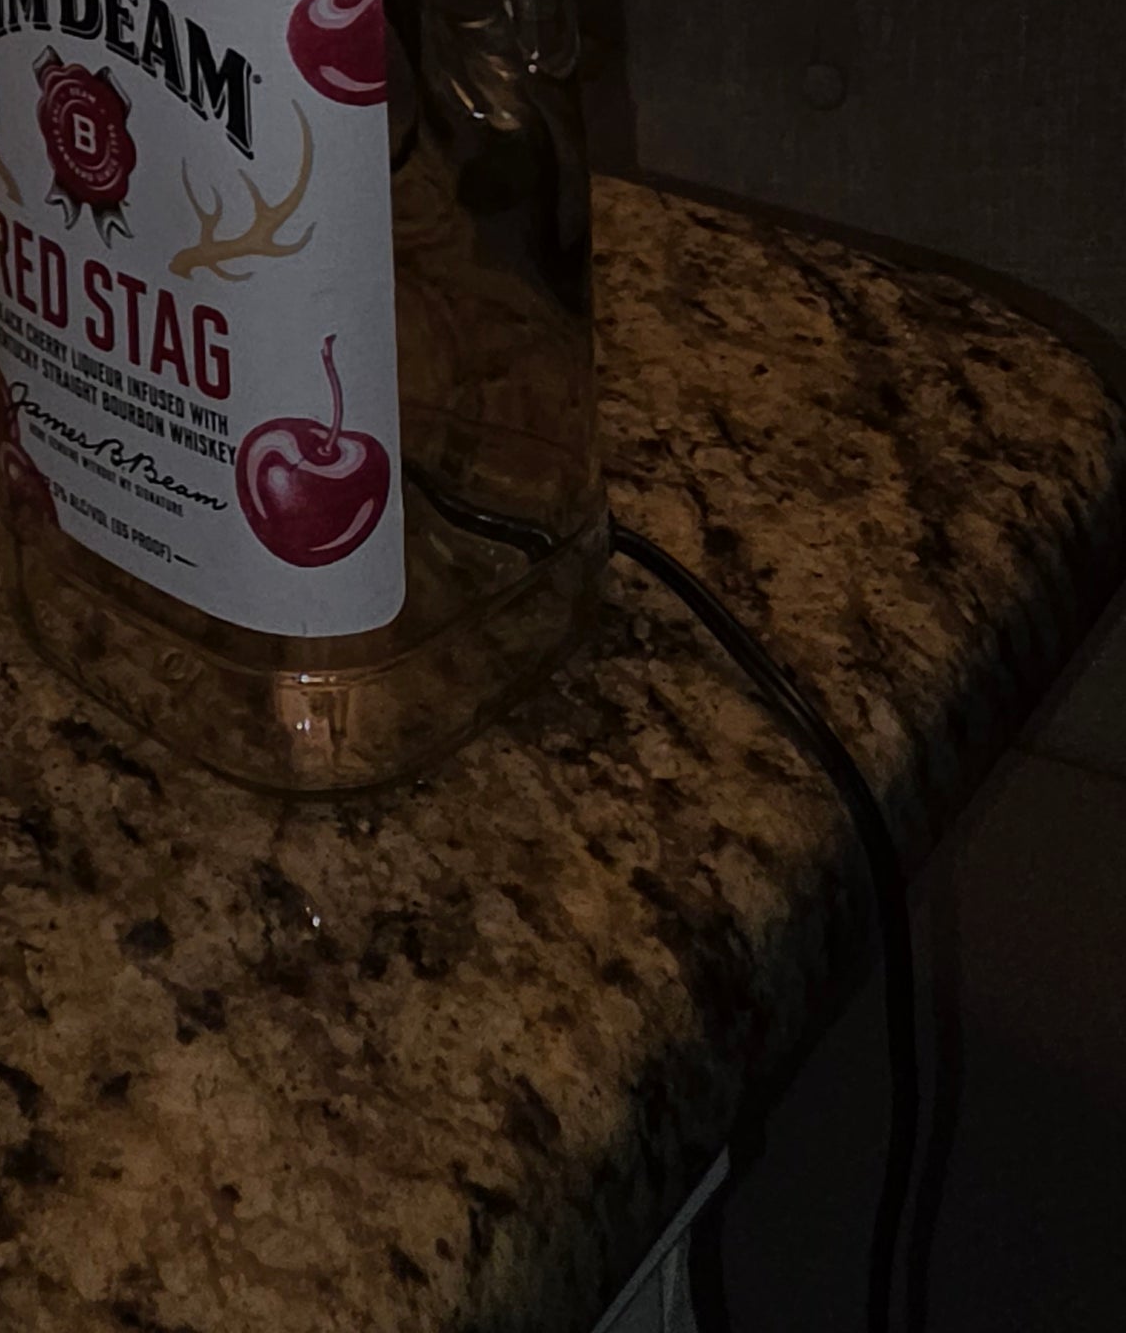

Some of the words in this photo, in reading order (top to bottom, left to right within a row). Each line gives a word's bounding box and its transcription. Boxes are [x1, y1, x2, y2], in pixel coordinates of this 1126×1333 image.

[72, 112, 97, 155] B
[82, 258, 233, 402] STAG
[71, 346, 124, 393] LIQUEUR
[126, 374, 185, 419] INFUSED
[188, 401, 229, 437] WITH
[101, 390, 165, 438] BOURBON
[168, 420, 237, 467] WHISKEY
[7, 381, 91, 449] James
[128, 452, 228, 511] Beam
